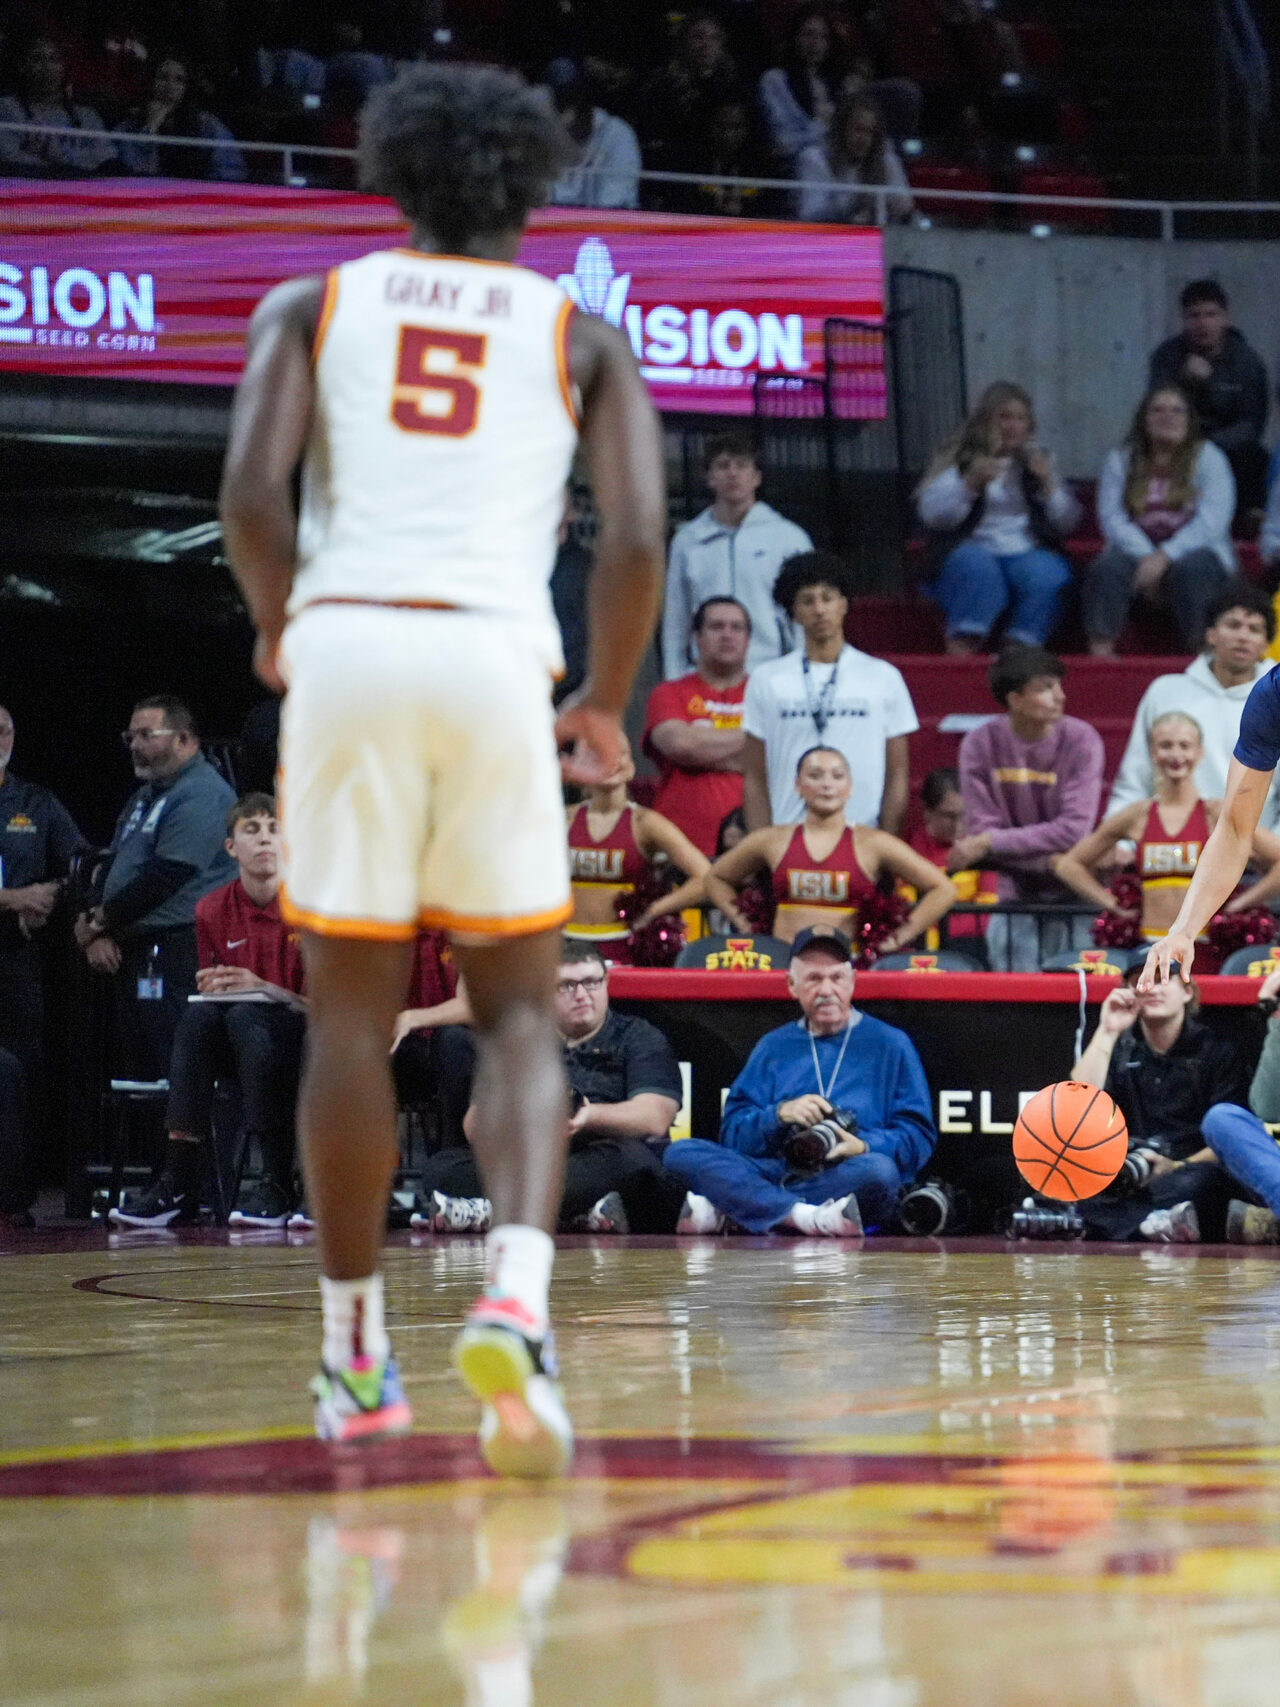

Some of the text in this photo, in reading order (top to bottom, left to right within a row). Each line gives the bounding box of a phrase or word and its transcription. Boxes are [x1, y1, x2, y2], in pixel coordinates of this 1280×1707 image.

[385, 272, 463, 310] GRAY
[390, 323, 487, 439] 5
[788, 868, 849, 902] ISU
[705, 953, 772, 972] STATE
[939, 1091, 1050, 1134] EL
